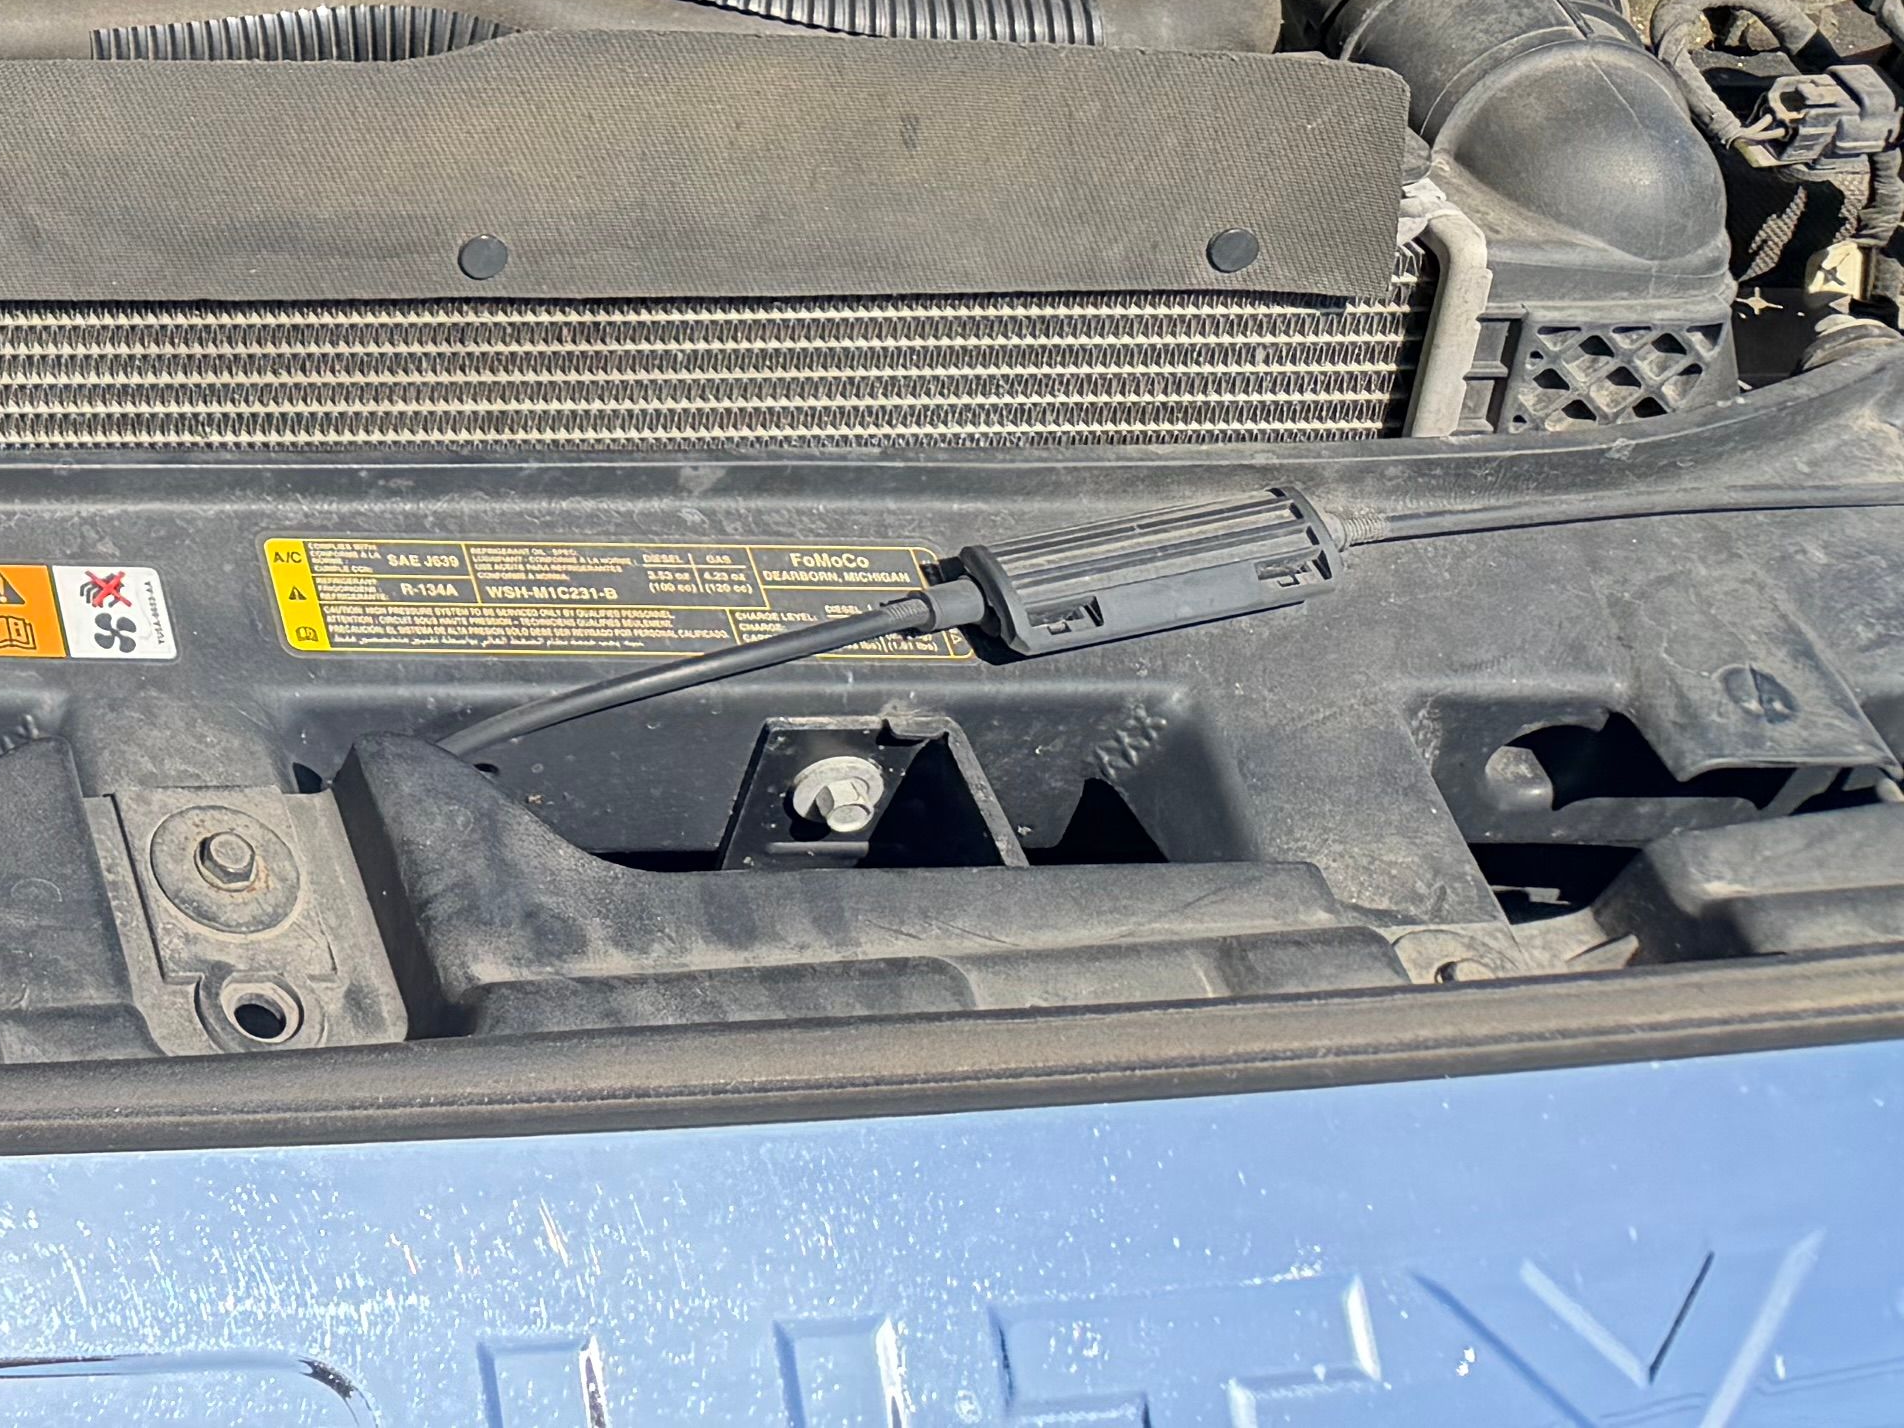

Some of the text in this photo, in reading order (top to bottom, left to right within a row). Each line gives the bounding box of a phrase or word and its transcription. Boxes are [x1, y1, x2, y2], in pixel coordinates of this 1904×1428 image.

[273, 551, 303, 564] A/C
[386, 554, 421, 567] SAE
[423, 555, 460, 568] J639
[642, 554, 732, 564] DIESEL GAS
[789, 552, 870, 569] FoMoCo
[762, 570, 911, 584] DEARBORN, MICHIGAN
[400, 583, 459, 597] R-134A
[486, 586, 619, 600] WSH-M1C231-B
